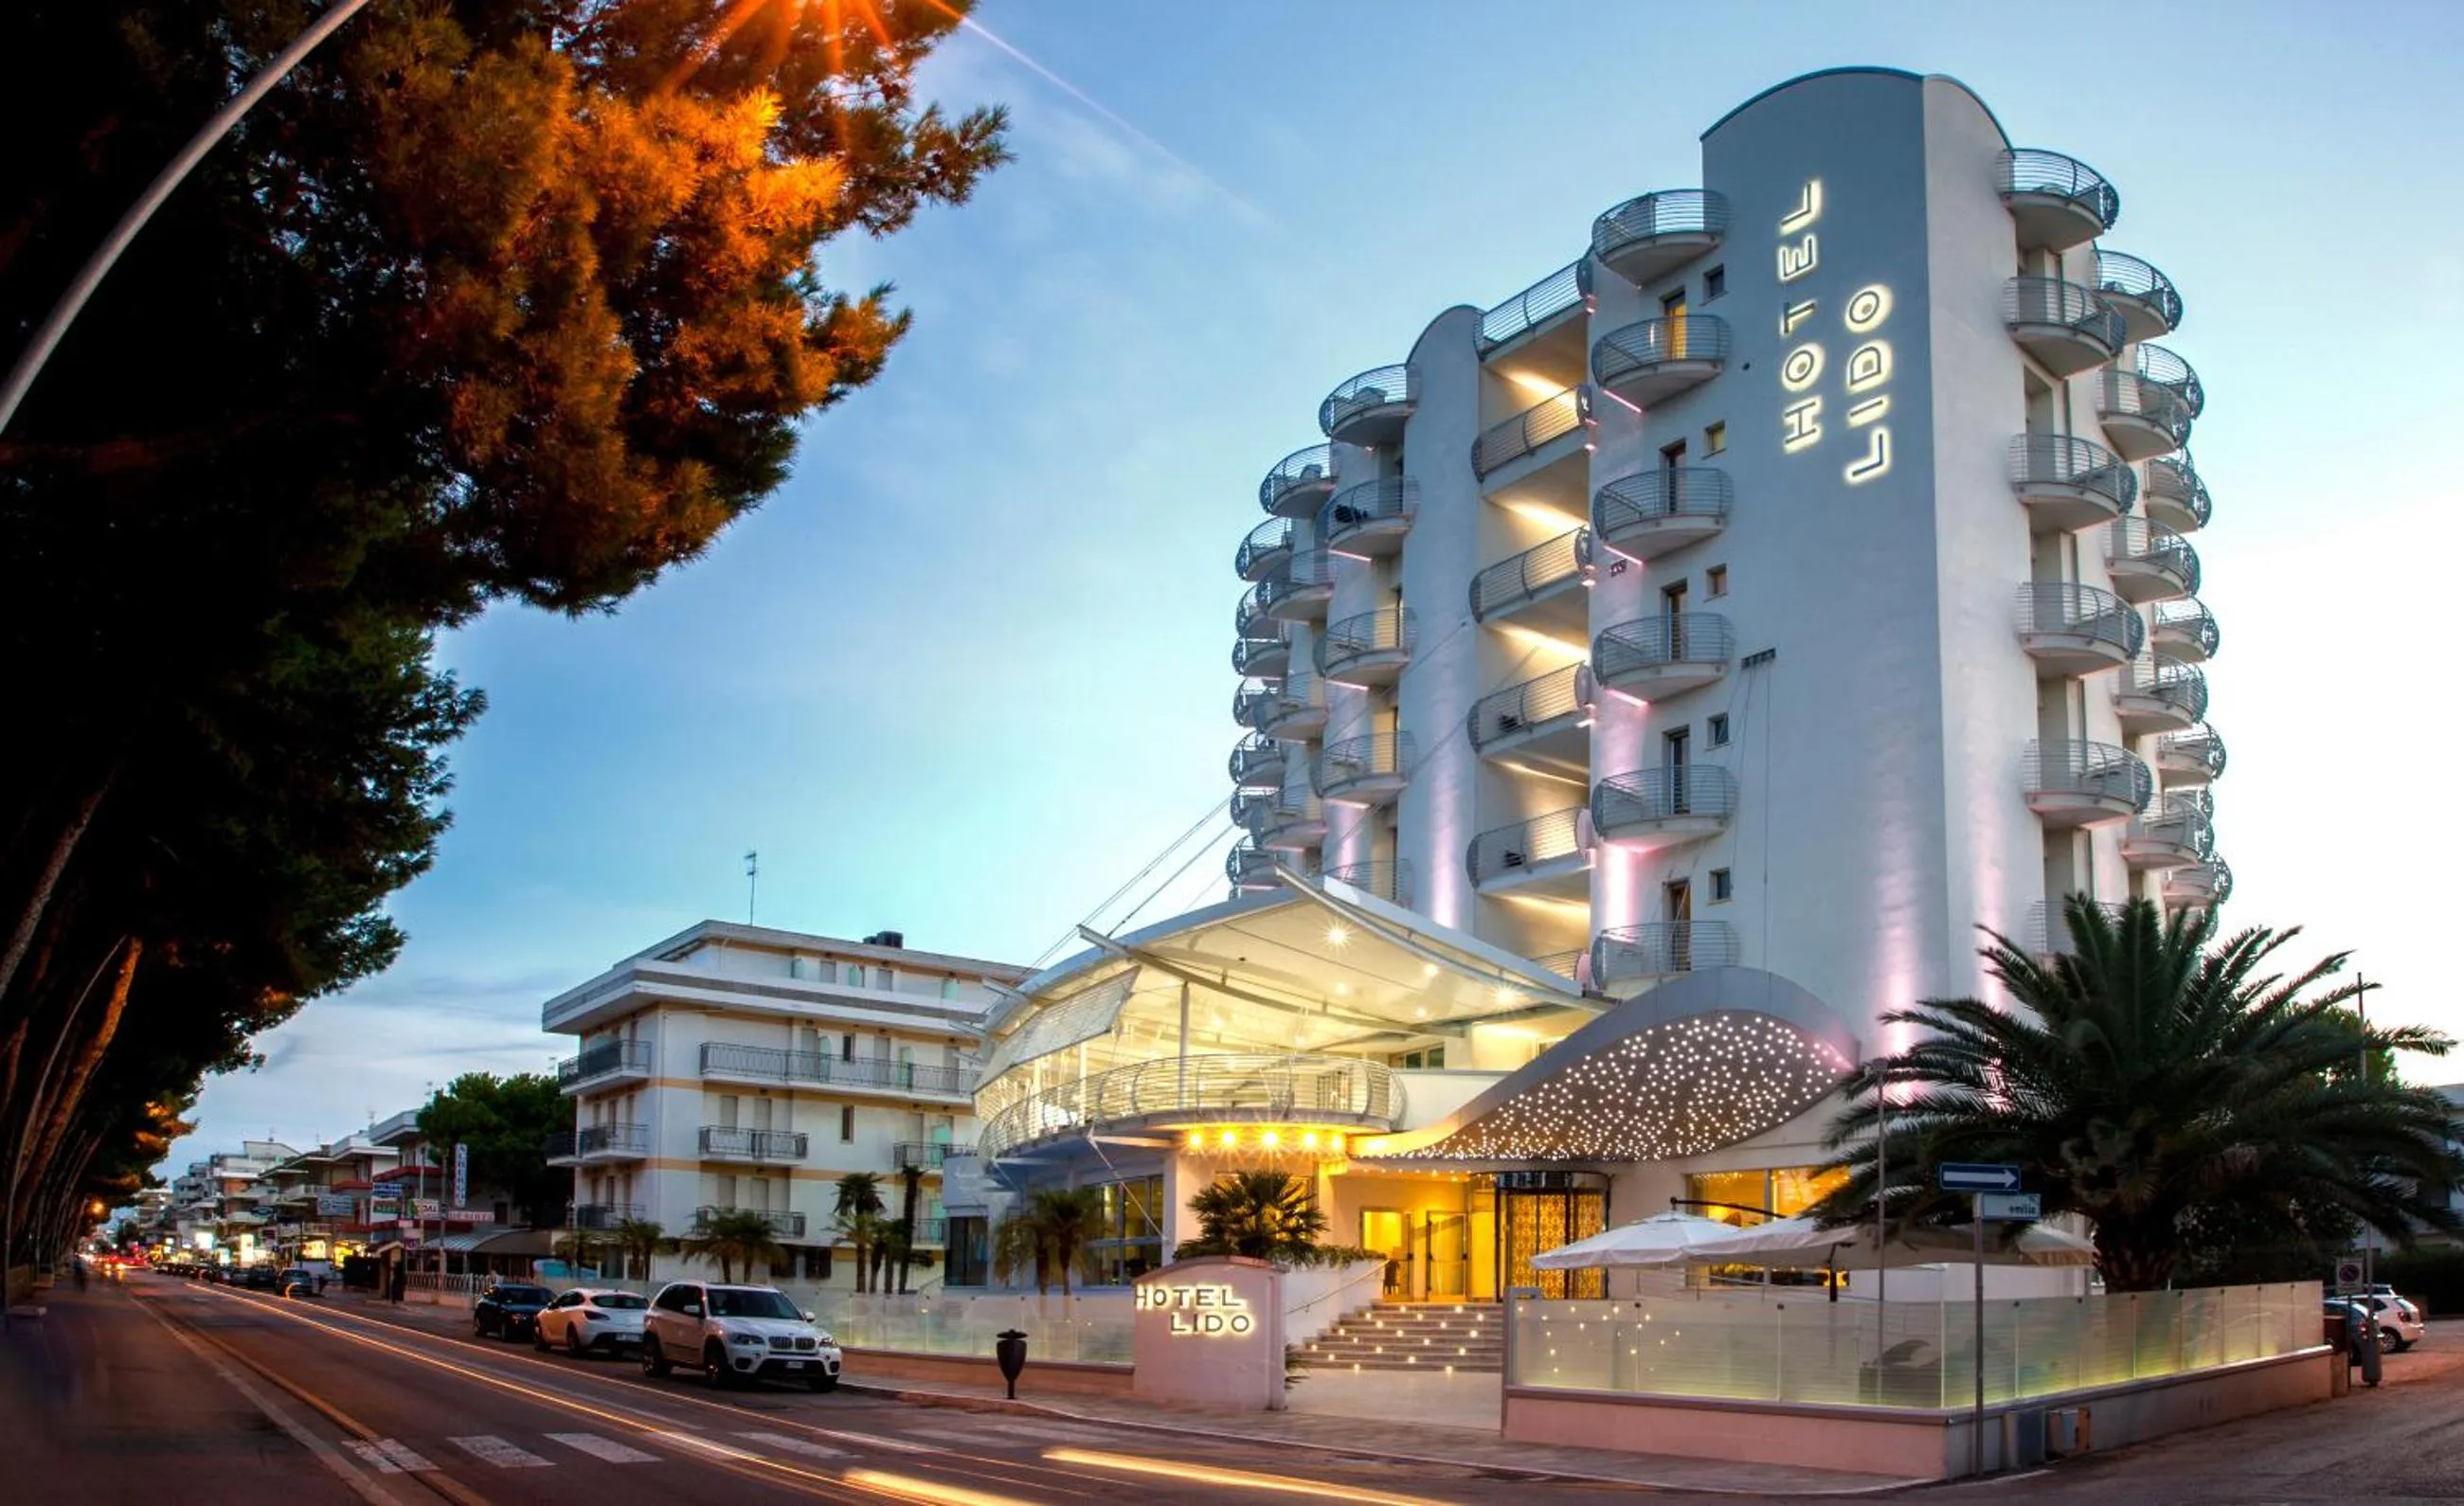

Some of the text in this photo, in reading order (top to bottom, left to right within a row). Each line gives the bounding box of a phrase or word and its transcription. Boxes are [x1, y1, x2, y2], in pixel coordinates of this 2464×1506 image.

[1779, 180, 1822, 452] HOTEL
[1846, 285, 1891, 484] LIDO
[1135, 1285, 1244, 1309] HOTEL
[1170, 1313, 1250, 1334] LIDO
